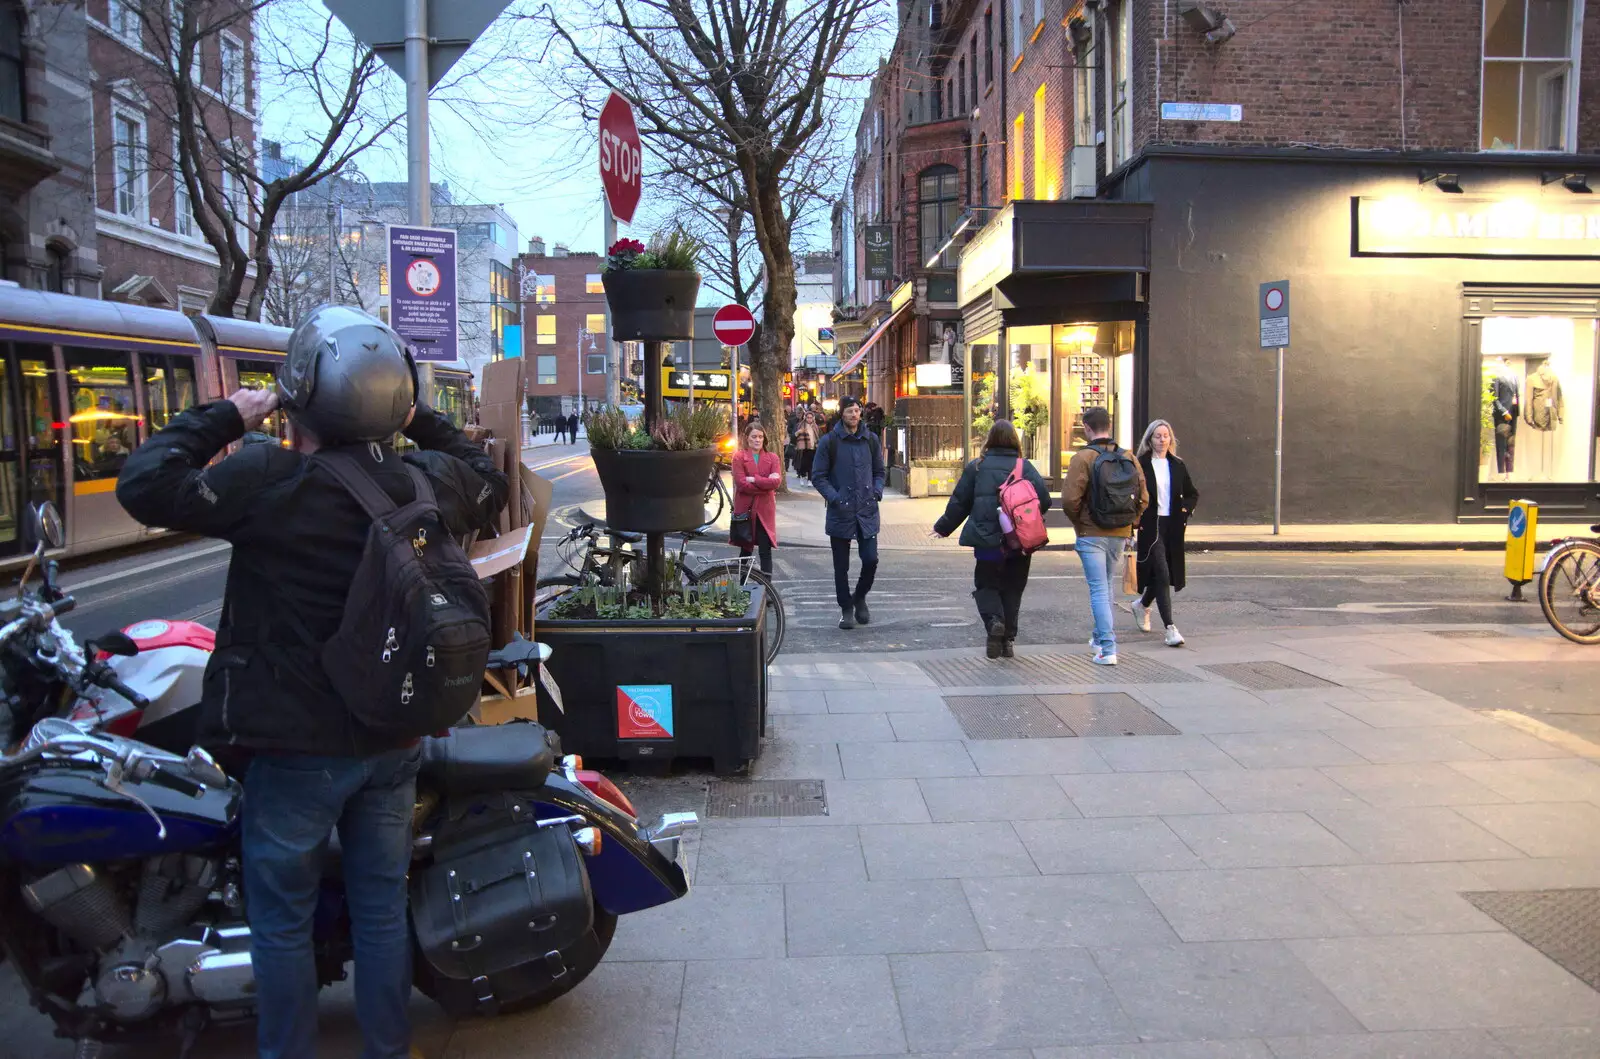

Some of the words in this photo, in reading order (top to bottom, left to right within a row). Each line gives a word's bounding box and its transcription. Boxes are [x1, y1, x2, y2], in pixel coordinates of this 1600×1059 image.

[1232, 108, 1240, 117] 2
[601, 128, 640, 187] STOP
[875, 231, 882, 243] B
